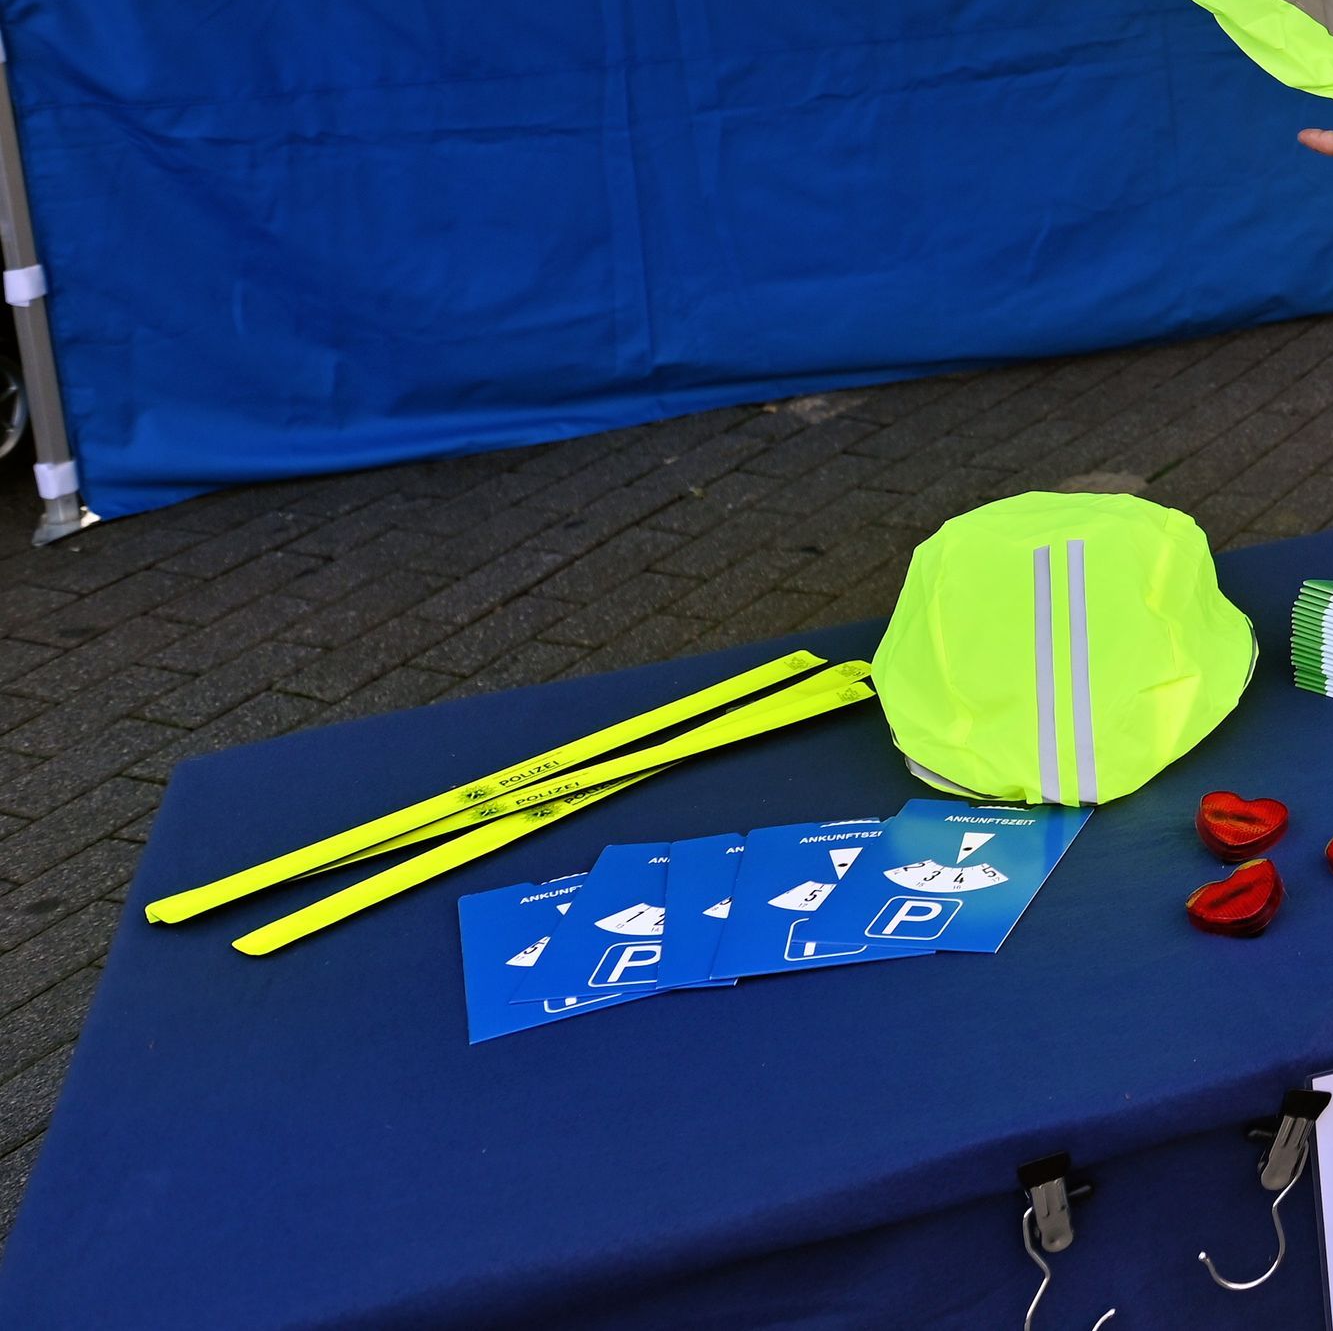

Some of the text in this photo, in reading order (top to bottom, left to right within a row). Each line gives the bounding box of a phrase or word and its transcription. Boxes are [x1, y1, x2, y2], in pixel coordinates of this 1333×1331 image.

[498, 759, 561, 788] POLIZEI
[515, 780, 581, 807] POLIZEI
[944, 814, 1037, 827] ANKUNFTSZEIT
[902, 862, 997, 884] 2 3 4 5
[804, 889, 823, 902] 5
[625, 910, 646, 924] 1
[881, 900, 943, 935] P
[606, 945, 663, 983] P
